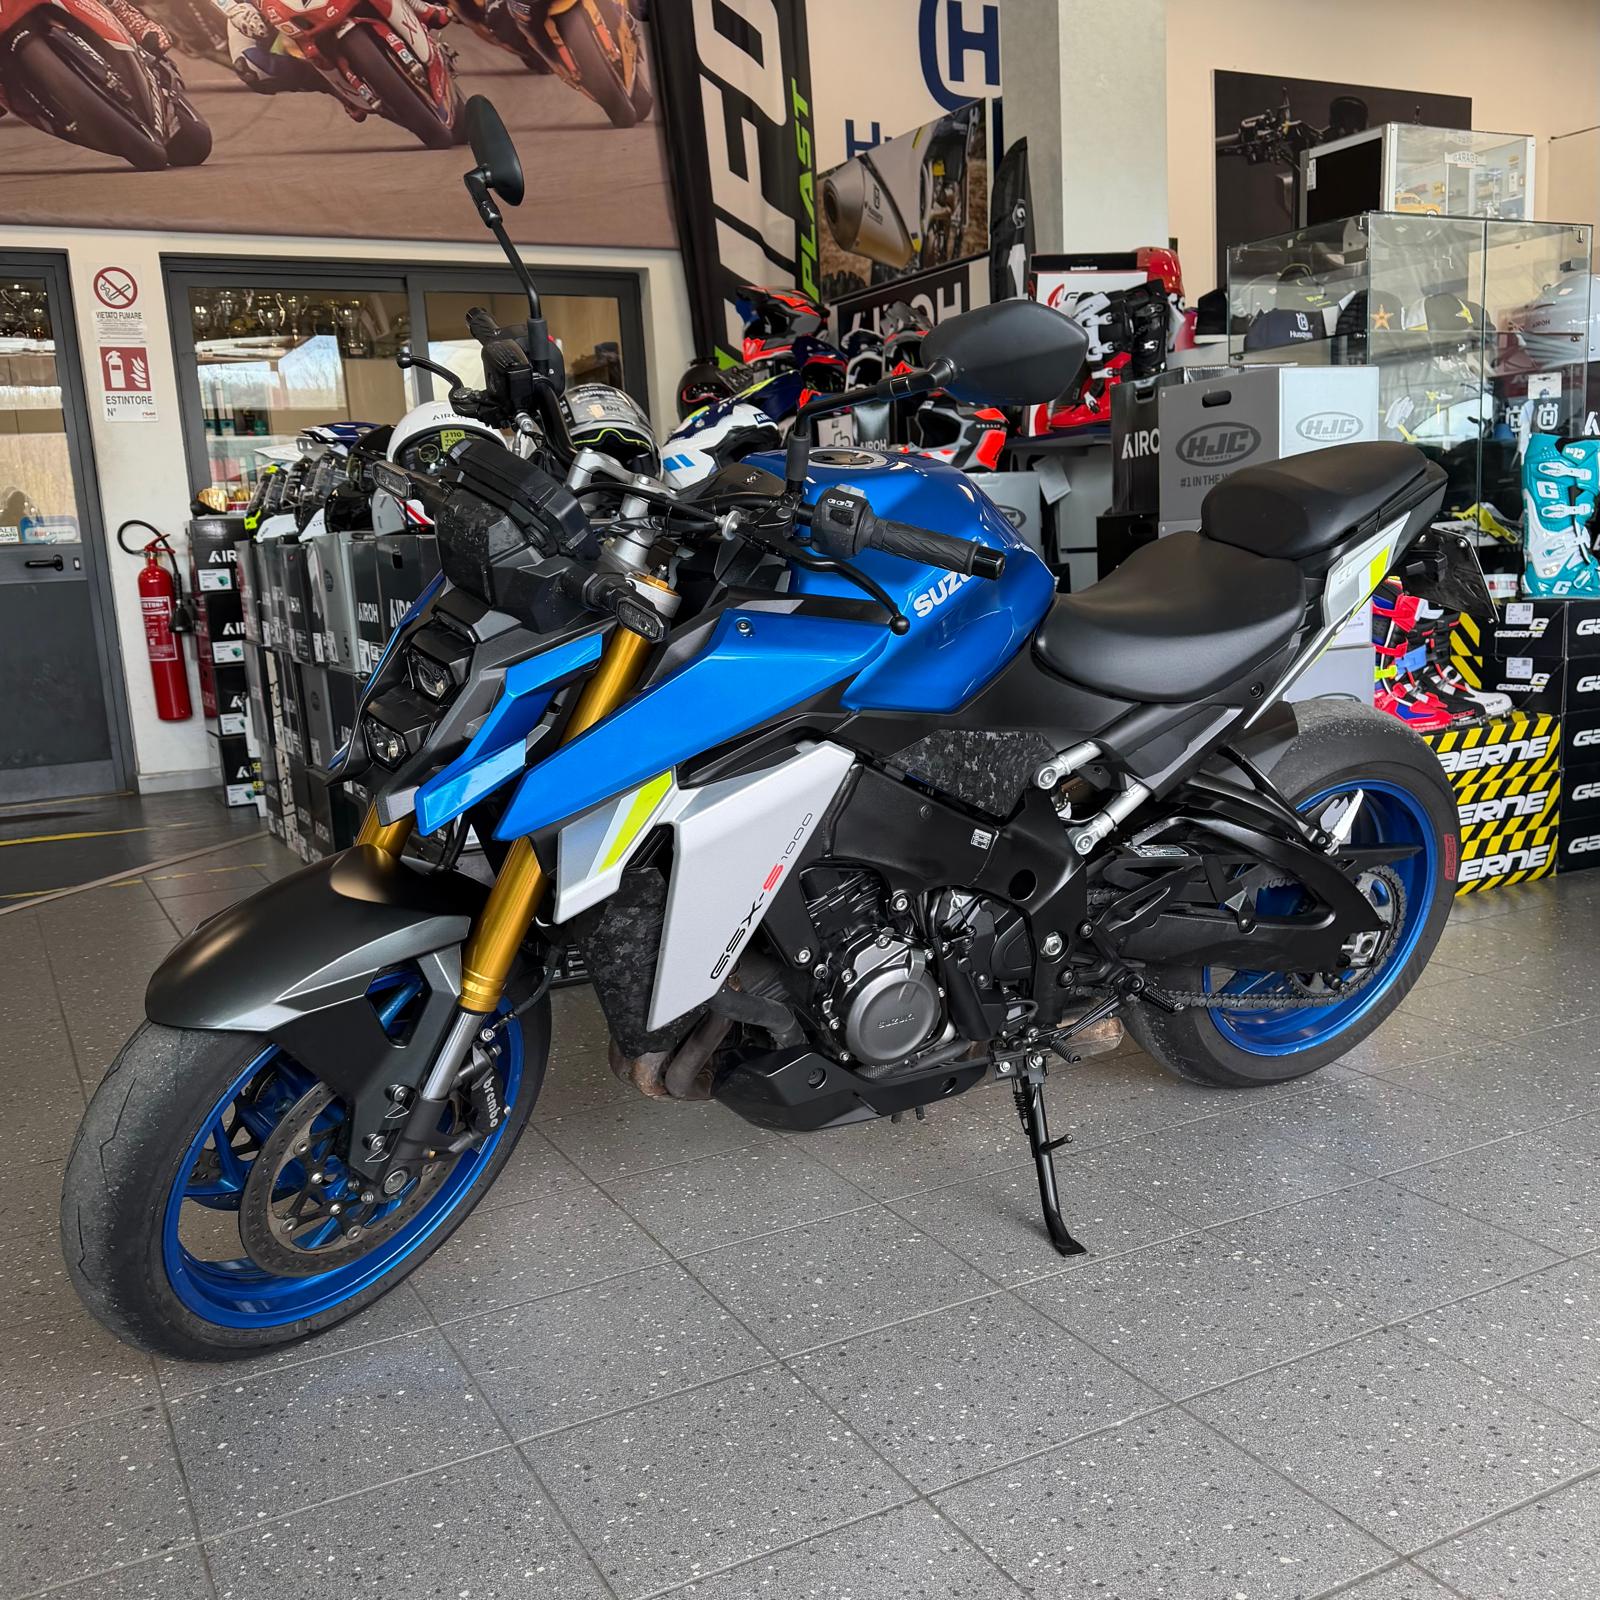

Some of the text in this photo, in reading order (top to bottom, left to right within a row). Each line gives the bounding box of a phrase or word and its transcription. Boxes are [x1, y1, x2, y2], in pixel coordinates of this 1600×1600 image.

[791, 76, 821, 304] PLAST
[96, 311, 142, 320] VIETATO FUMARE
[105, 395, 153, 405] ESTINTORE
[1304, 419, 1355, 435] HJC
[1186, 430, 1249, 458] HJC
[359, 602, 379, 624] AIROH
[483, 1075, 501, 1128] brembo
